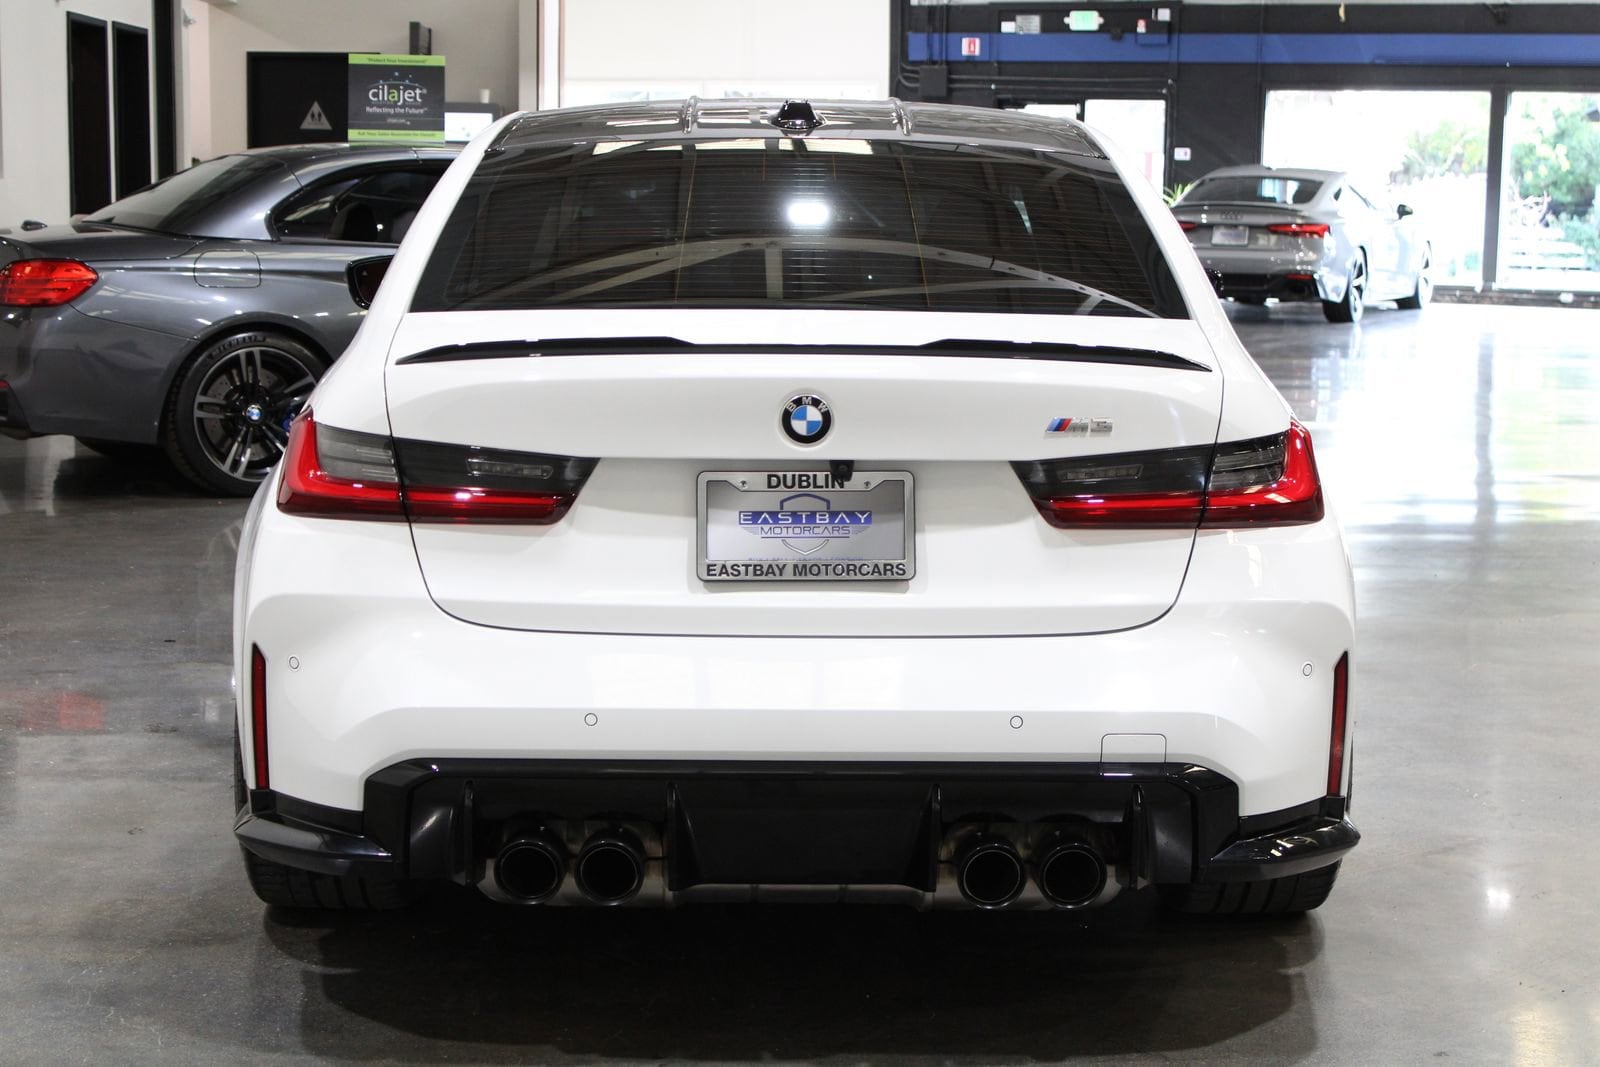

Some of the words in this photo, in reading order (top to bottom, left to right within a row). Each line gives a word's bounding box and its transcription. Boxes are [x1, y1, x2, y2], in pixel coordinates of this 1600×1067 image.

[365, 106, 395, 114] Reflecting
[786, 396, 829, 413] BMW
[766, 473, 845, 490] DUBLIN
[739, 511, 872, 525] EASTBAY
[760, 525, 851, 536] MOTORCARS
[706, 563, 787, 577] EASTBAY
[792, 563, 906, 577] MOTORCARS
